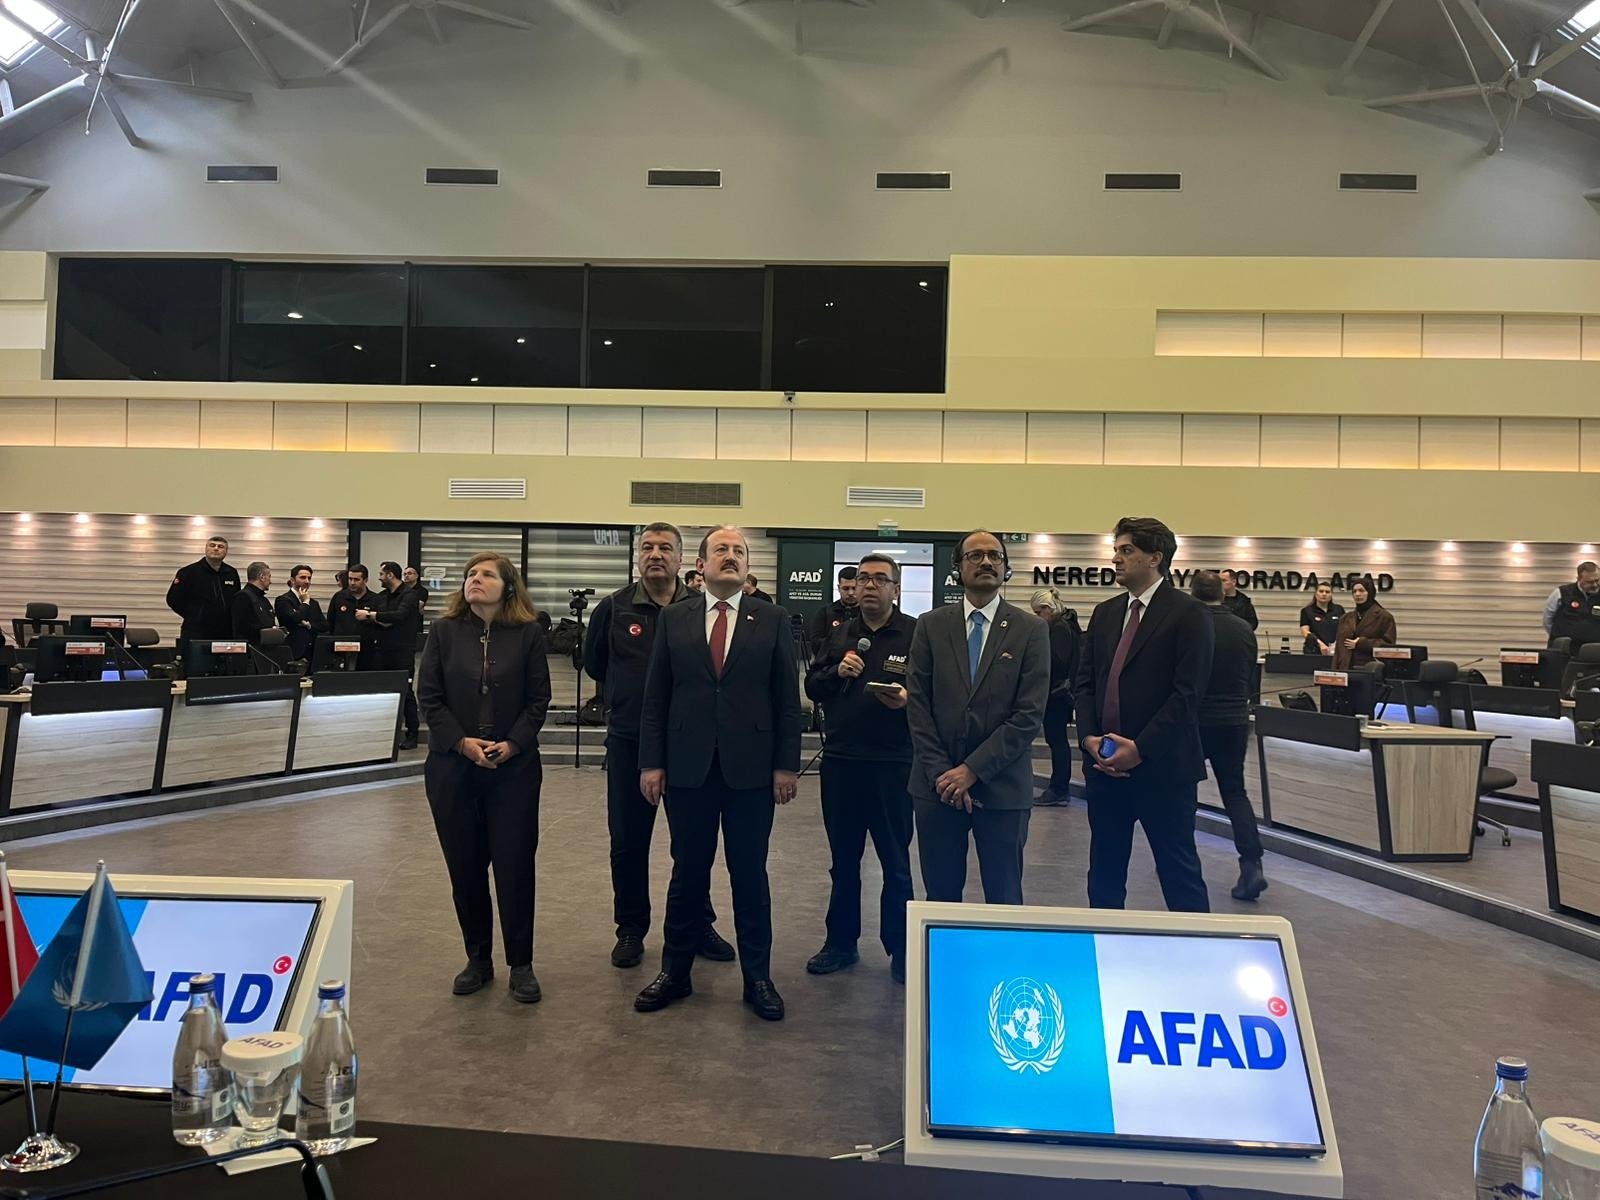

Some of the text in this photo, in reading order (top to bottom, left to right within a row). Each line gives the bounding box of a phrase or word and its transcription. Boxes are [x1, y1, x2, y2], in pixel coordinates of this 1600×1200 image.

[789, 571, 822, 583] AFAD
[1033, 566, 1117, 586] NERED
[1233, 570, 1319, 591] ORADA
[888, 654, 906, 663] AFAD
[239, 1037, 284, 1048] AFAD
[1118, 1010, 1287, 1070] AFAD
[1557, 1122, 1600, 1143] AFA
